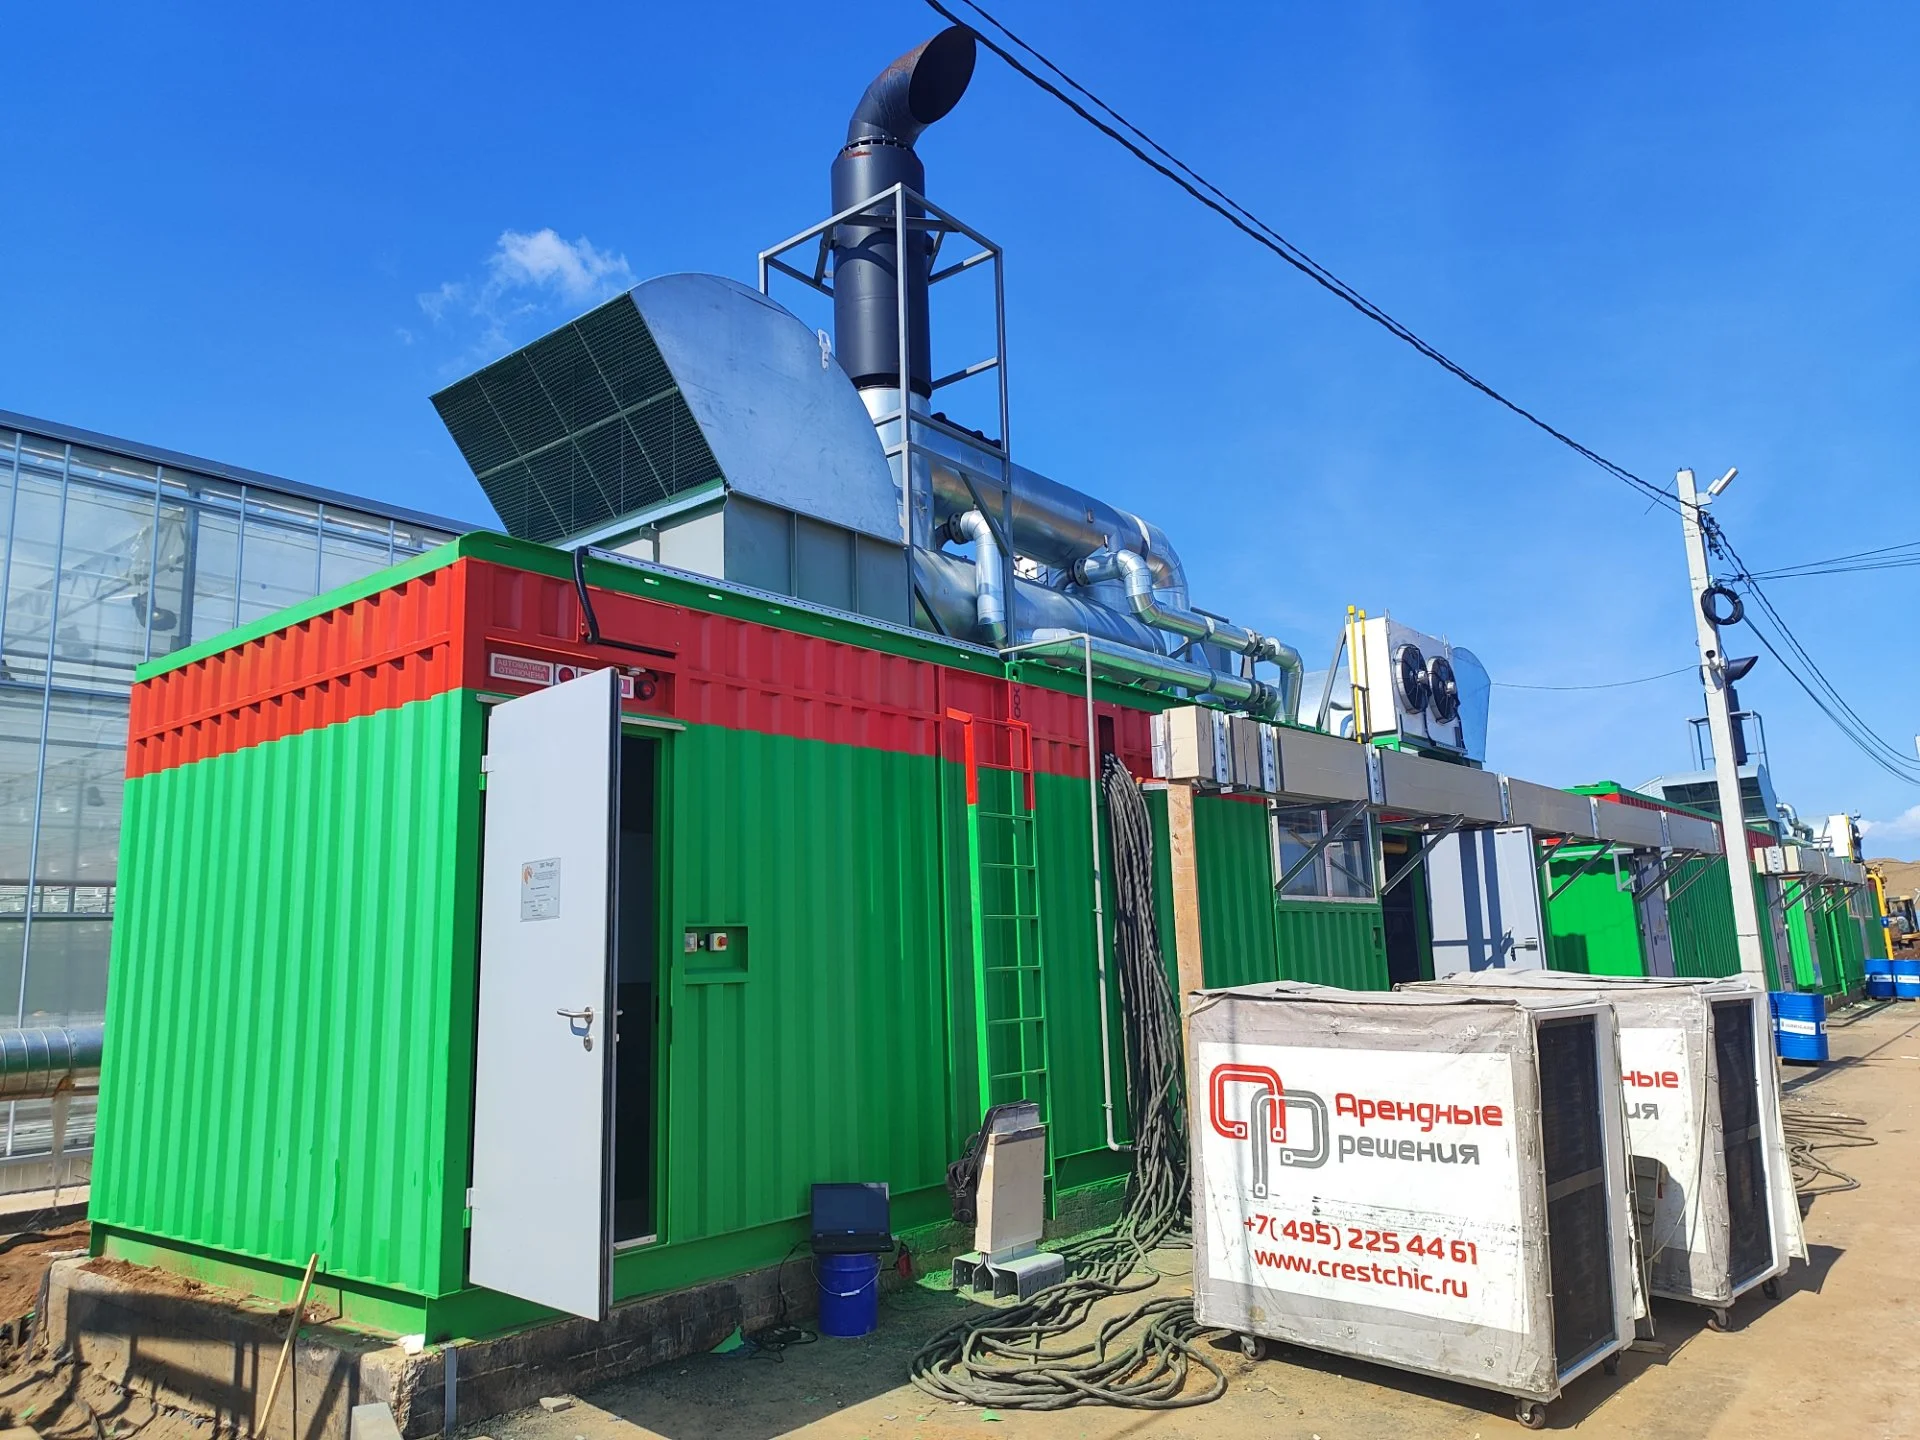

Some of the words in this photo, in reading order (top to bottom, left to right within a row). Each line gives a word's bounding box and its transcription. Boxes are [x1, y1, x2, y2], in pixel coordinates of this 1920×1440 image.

[496, 659, 547, 673] АВТОМАТИКА
[498, 666, 546, 680] ОТКЛЮЧЕНА
[1335, 1093, 1503, 1132] Арендные
[1338, 1135, 1480, 1165] решения
[1347, 1228, 1400, 1254] 225
[1406, 1234, 1445, 1259] 44
[1450, 1240, 1477, 1265] 61
[1254, 1249, 1468, 1298] www.crestchic.ru
